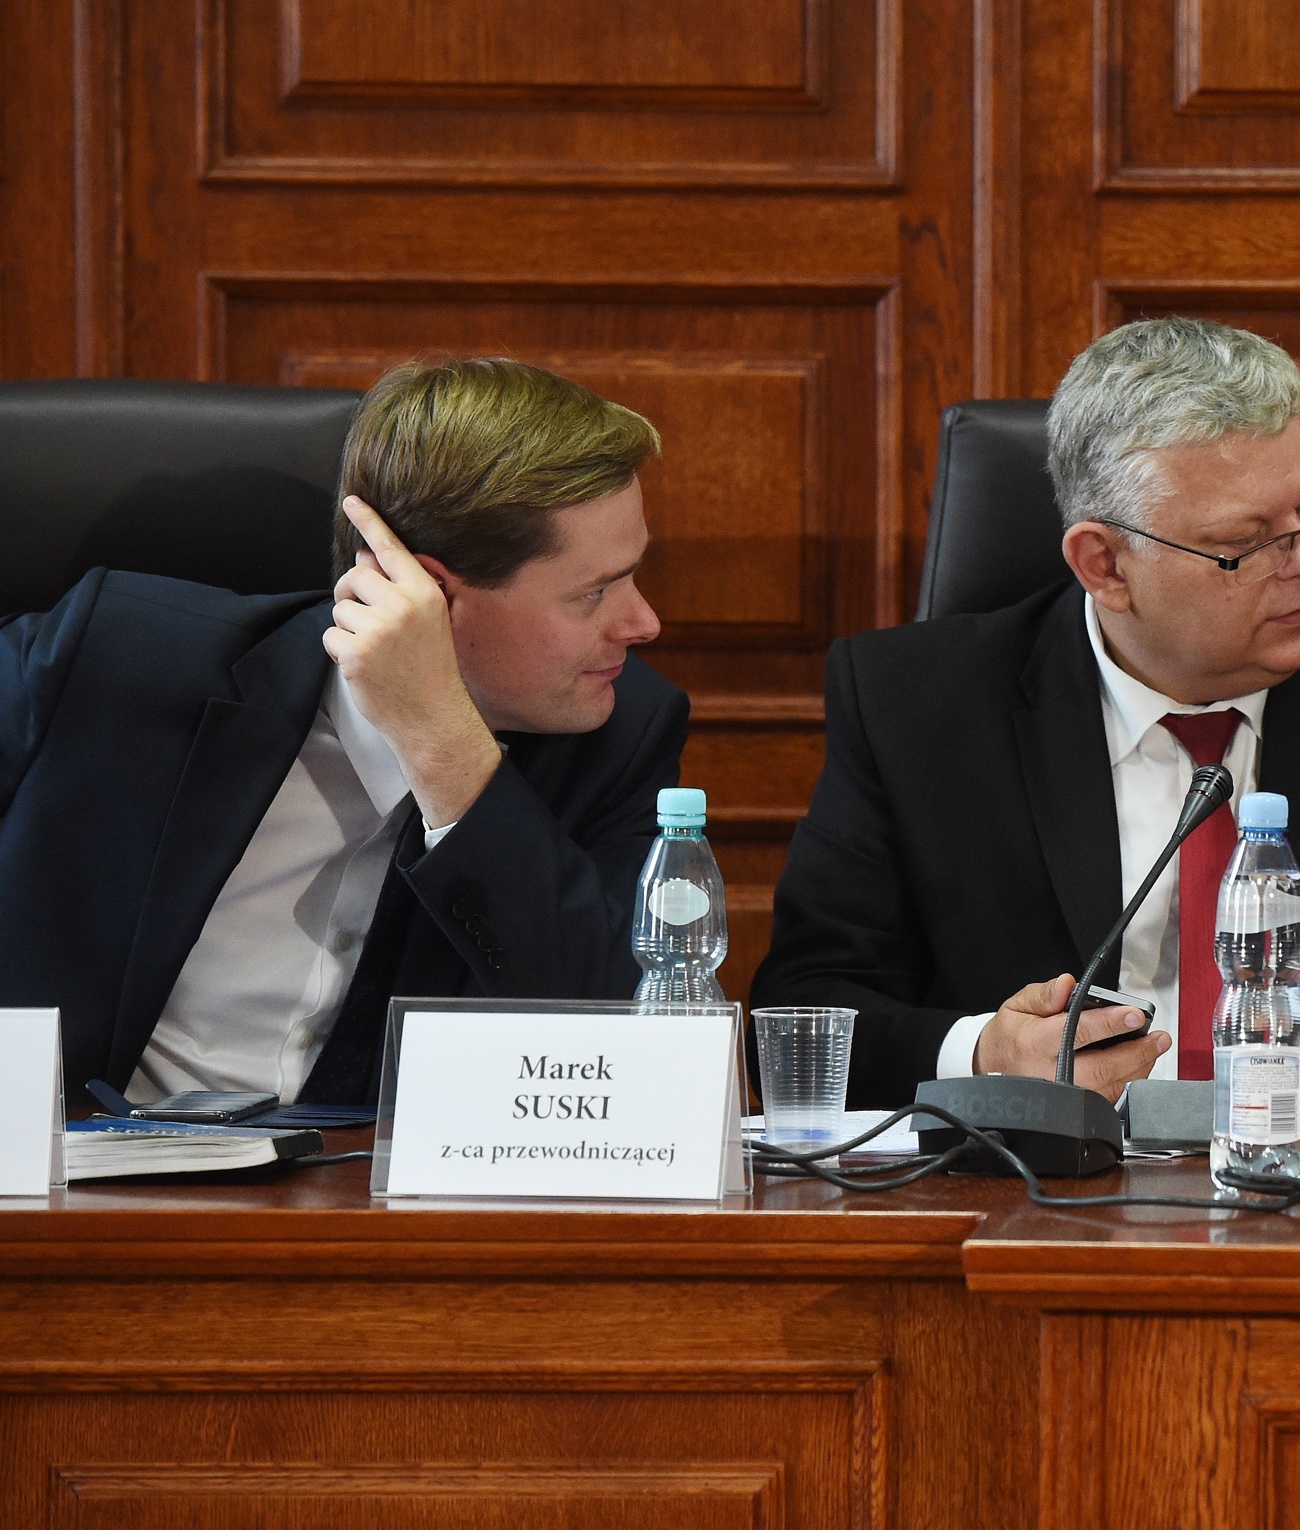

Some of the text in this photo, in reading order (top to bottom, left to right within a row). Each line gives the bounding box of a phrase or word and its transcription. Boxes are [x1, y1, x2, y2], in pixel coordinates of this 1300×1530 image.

[517, 1054, 614, 1081] Marek
[512, 1094, 611, 1121] SUSKI
[948, 1093, 1046, 1122] BOSCH
[440, 1140, 676, 1167] z-ca przewodniczącej
